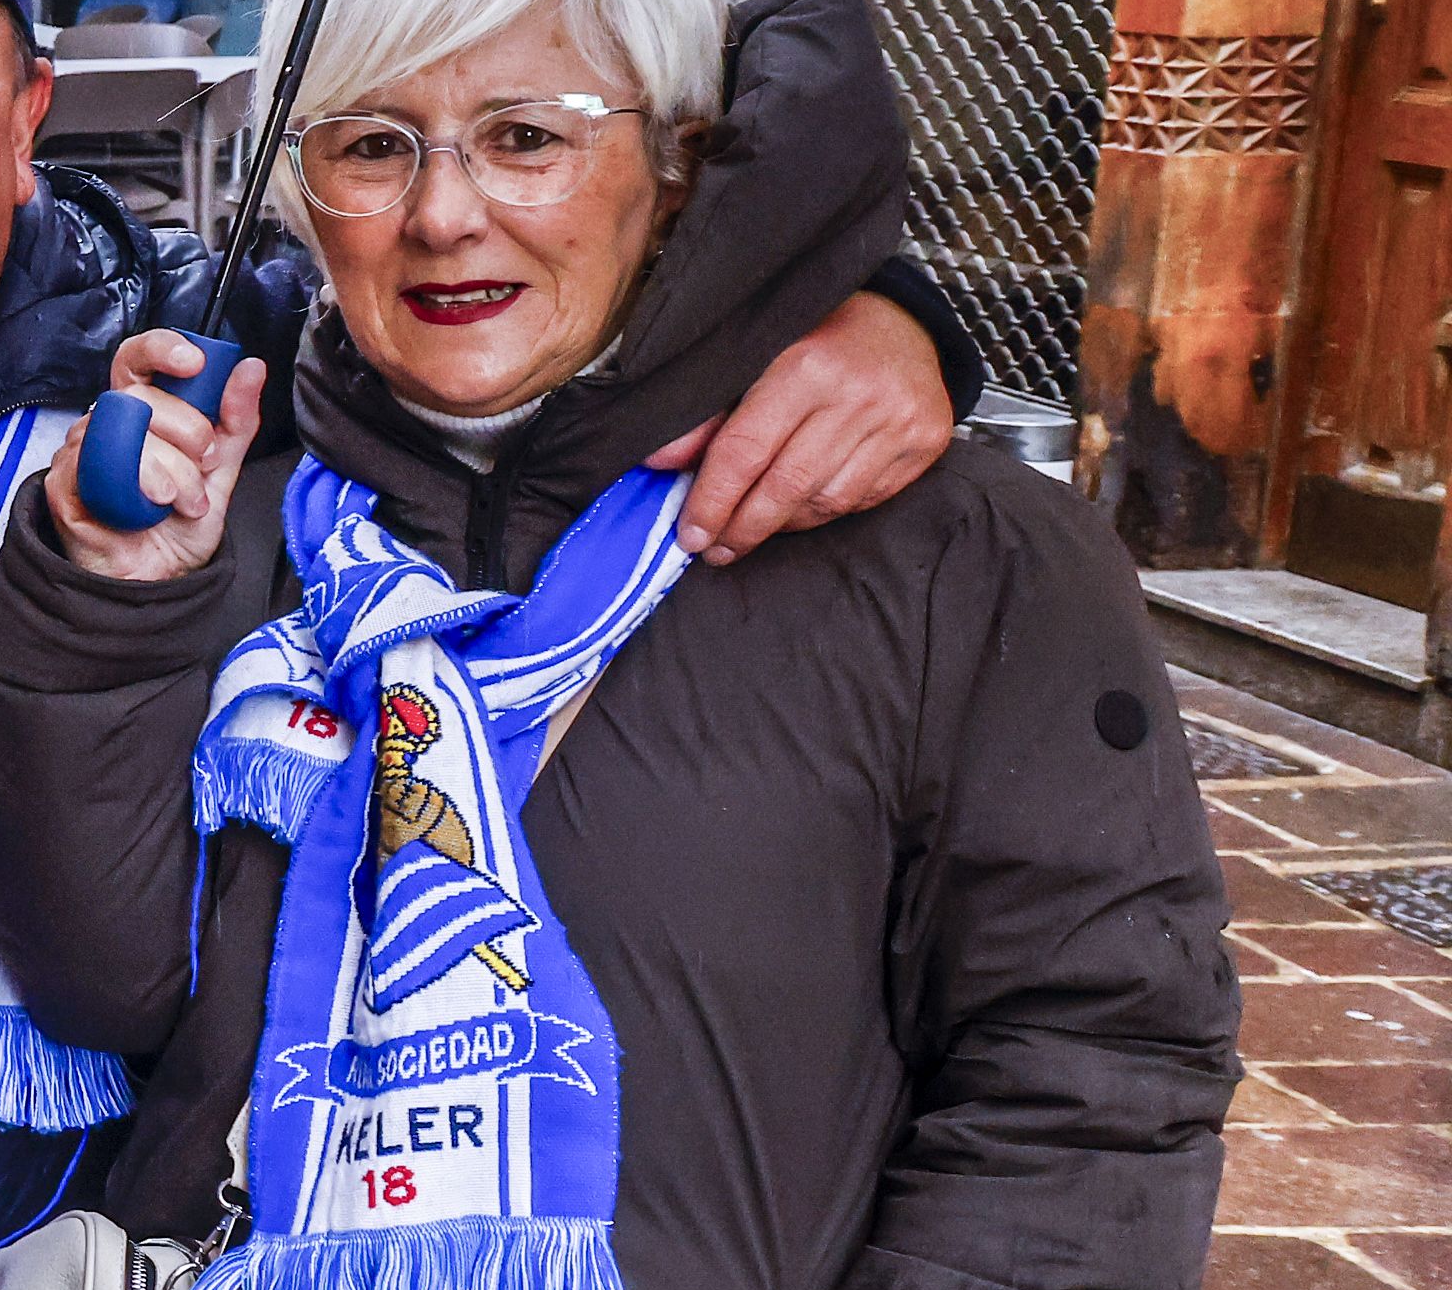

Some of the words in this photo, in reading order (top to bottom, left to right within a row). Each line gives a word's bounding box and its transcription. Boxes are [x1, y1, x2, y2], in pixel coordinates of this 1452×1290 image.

[286, 699, 340, 739] 18
[377, 1022, 516, 1087] SOCIEDAD
[334, 1103, 484, 1166] KELER
[361, 1164, 417, 1210] 18
